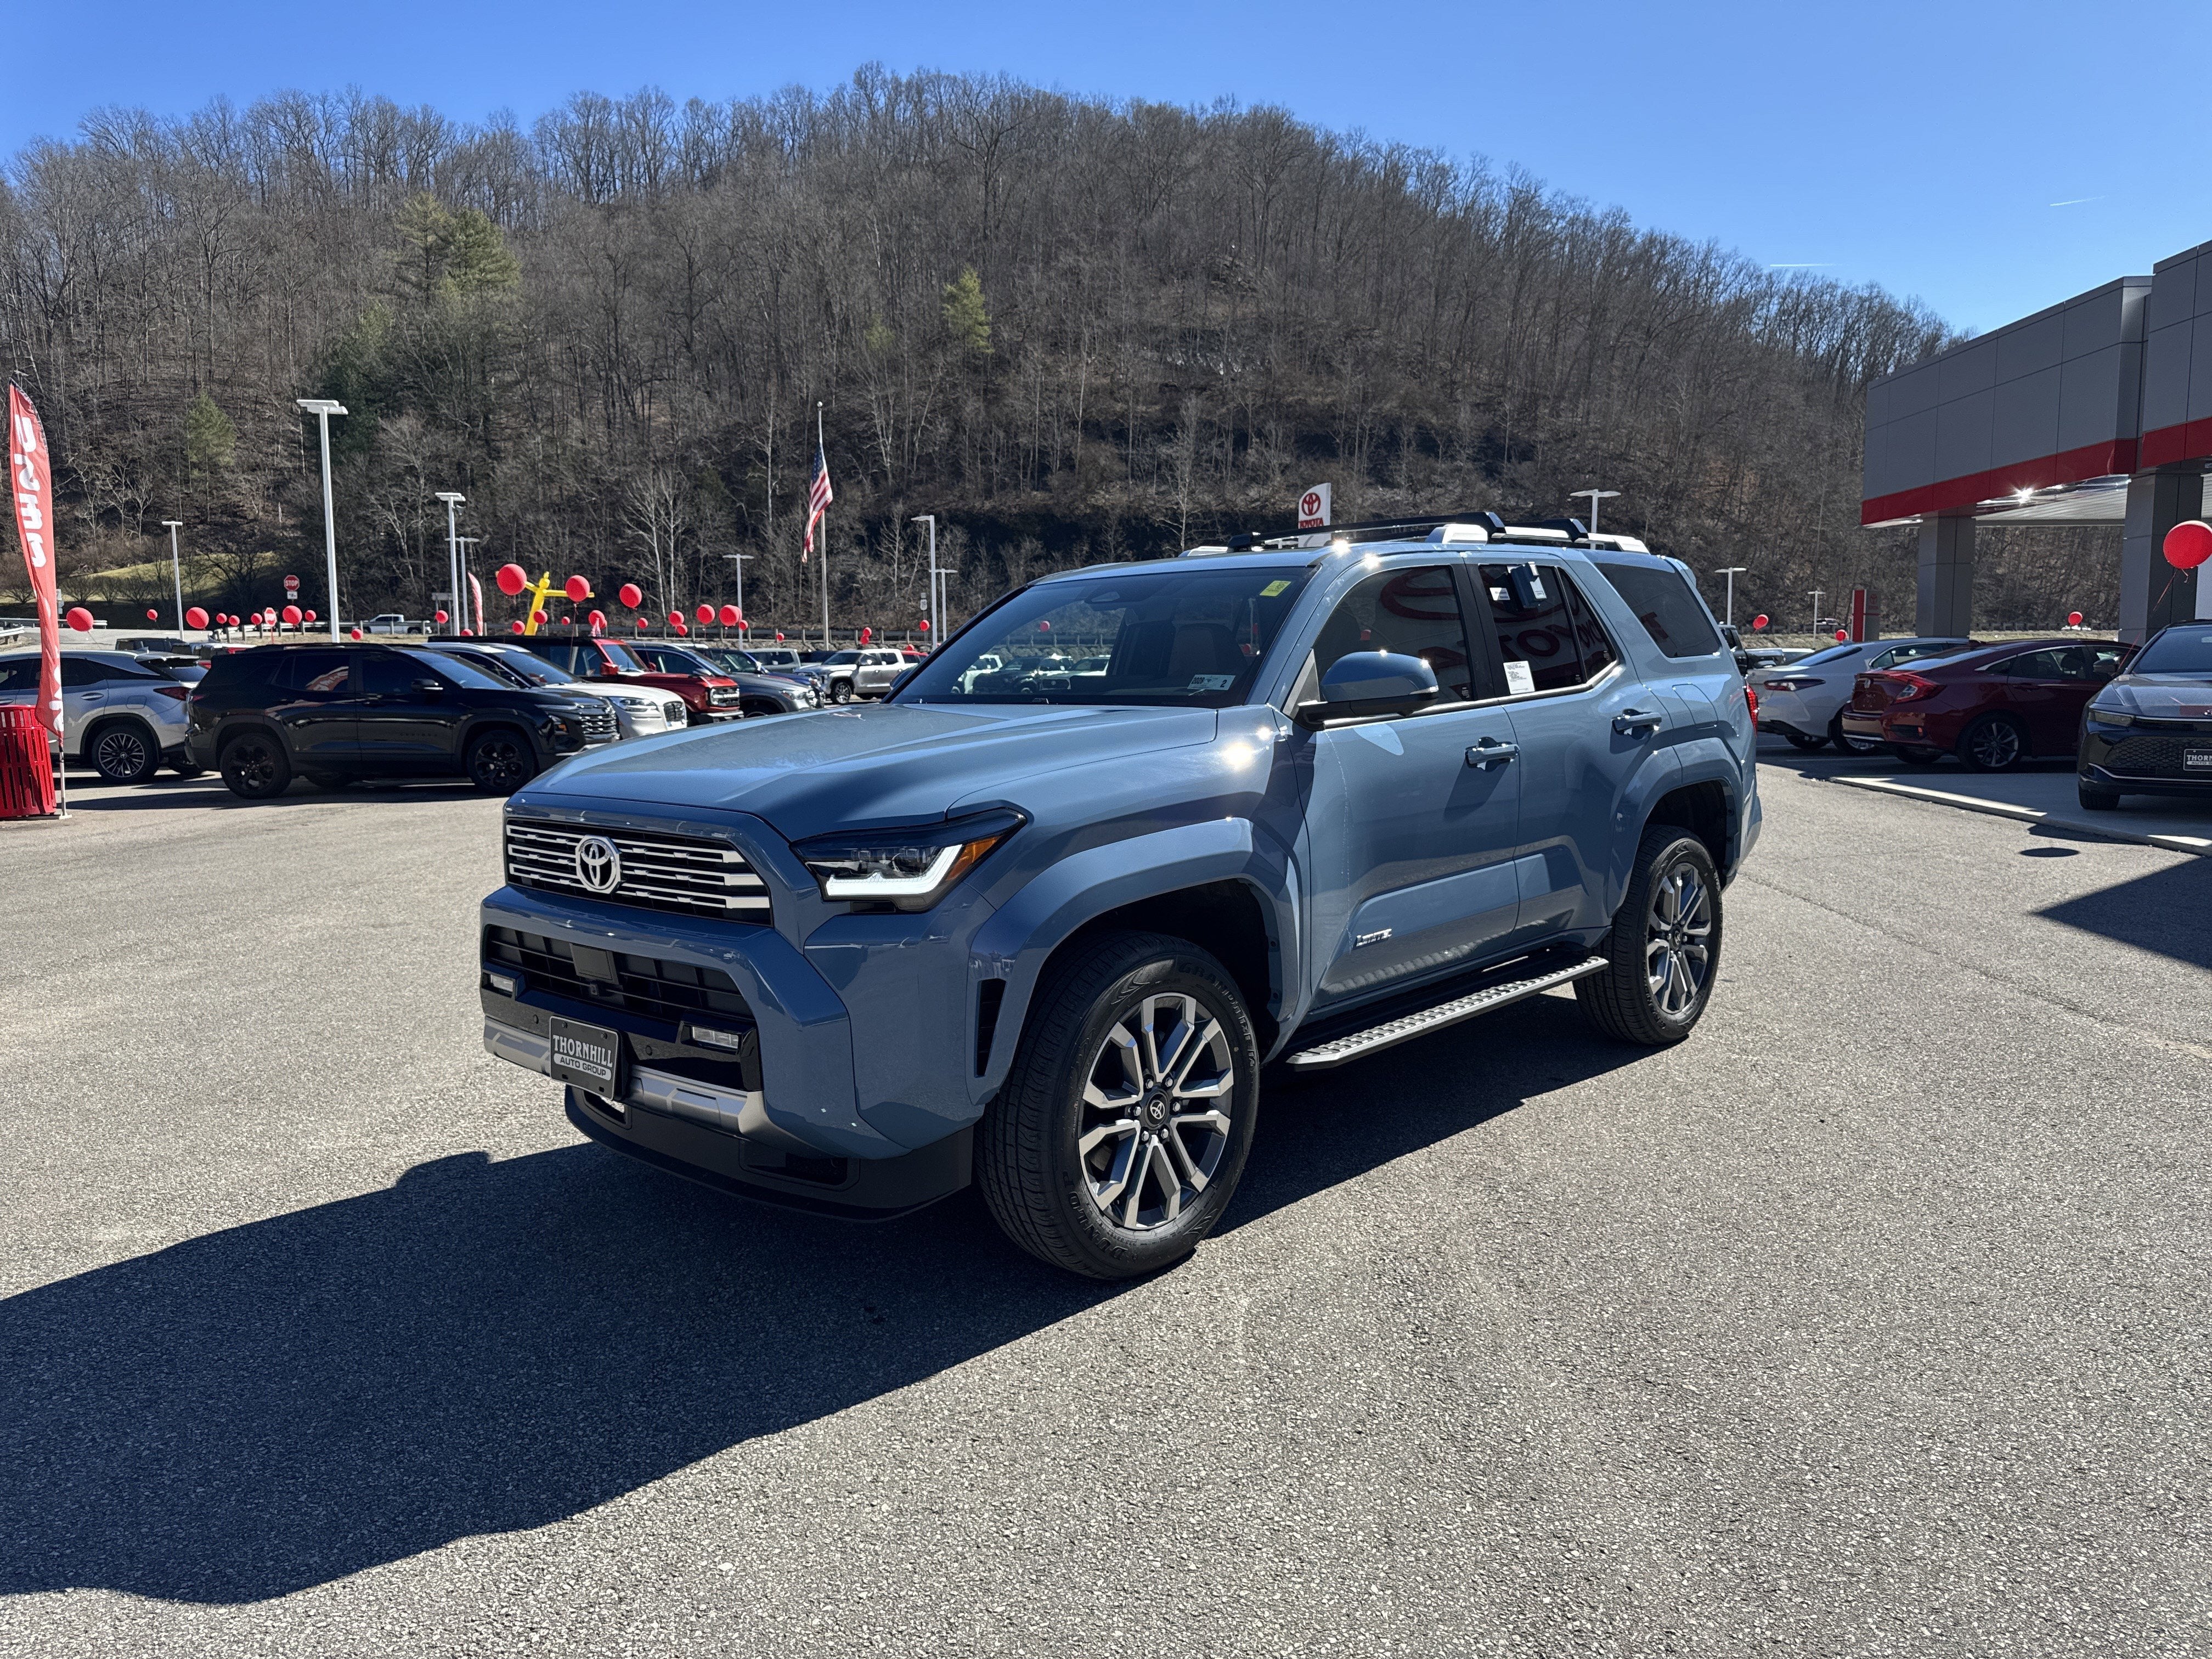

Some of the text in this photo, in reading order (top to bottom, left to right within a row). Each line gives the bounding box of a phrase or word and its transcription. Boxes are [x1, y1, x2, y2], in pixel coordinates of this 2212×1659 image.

[1299, 518, 1323, 528] TOYOTA
[1220, 679, 1228, 688] 2
[552, 1034, 613, 1068] THORNHILL
[560, 1056, 606, 1076] AUTO GROUP
